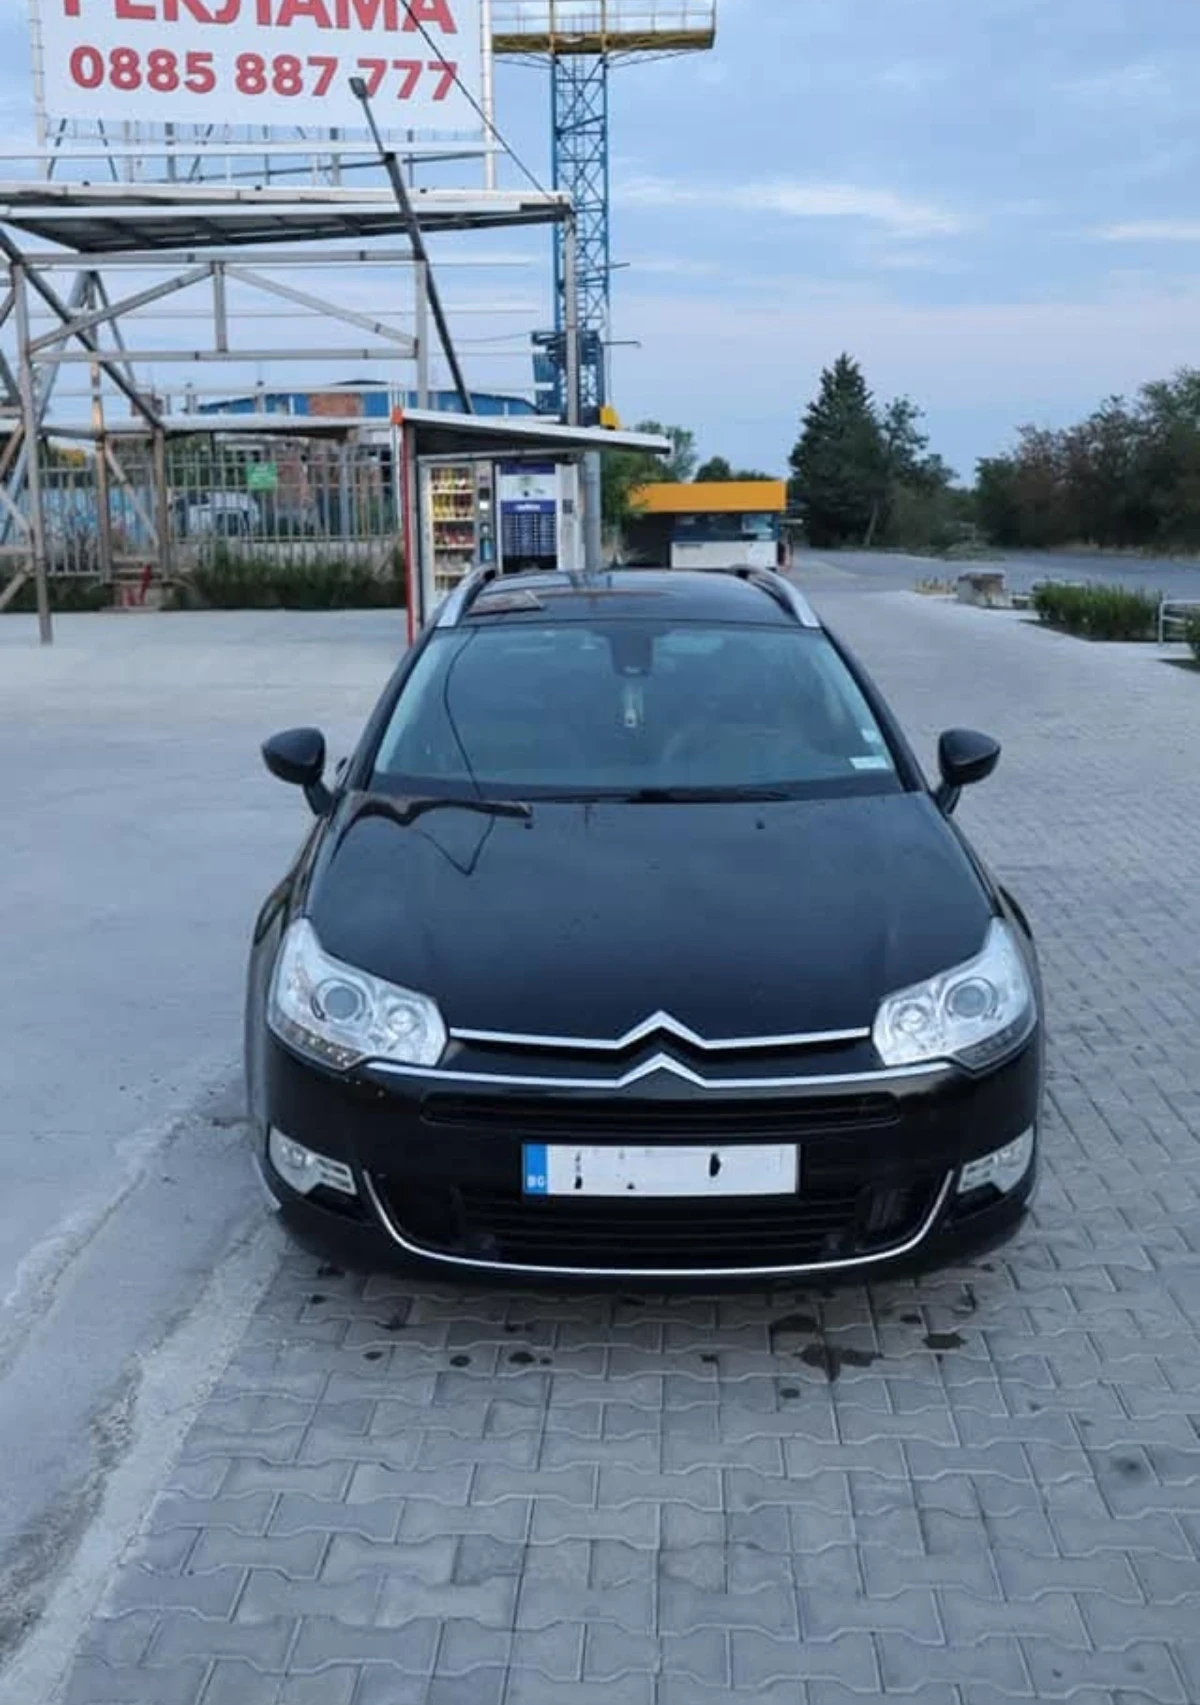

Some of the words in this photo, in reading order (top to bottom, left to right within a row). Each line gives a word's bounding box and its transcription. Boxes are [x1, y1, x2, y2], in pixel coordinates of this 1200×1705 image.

[64, 0, 458, 34] ЛАМА
[69, 46, 216, 94] 0885
[235, 53, 338, 97] 887
[357, 59, 458, 100] 777
